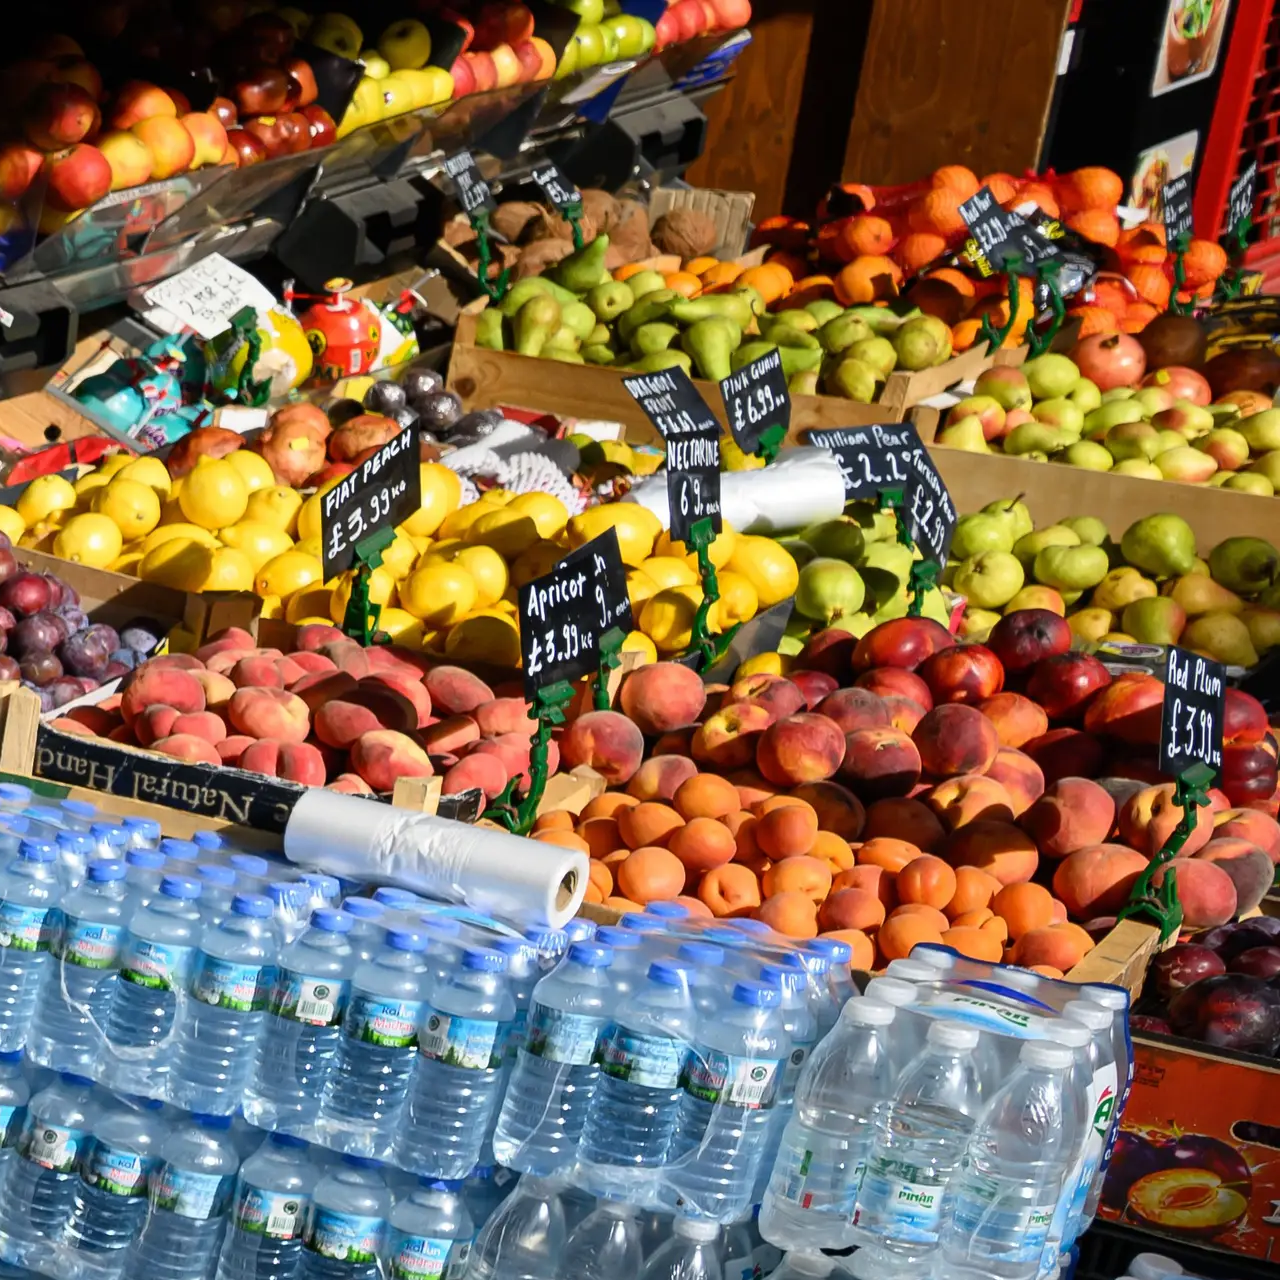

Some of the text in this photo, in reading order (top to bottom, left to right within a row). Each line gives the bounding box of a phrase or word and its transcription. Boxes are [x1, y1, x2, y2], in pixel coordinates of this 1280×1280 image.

[623, 371, 679, 401] DRAGON
[721, 351, 781, 401] PINK GUAVA
[643, 392, 678, 415] FRUIT
[732, 383, 776, 433] £6.99
[362, 428, 412, 484] PEACH
[667, 437, 720, 473] NECTARINE
[810, 423, 911, 450] William Pear
[911, 447, 942, 496] Turkish
[327, 487, 391, 560] £3.99
[527, 571, 588, 622] Apricot
[527, 623, 580, 677] £3.99
[1167, 649, 1222, 699] Red Plum
[1167, 697, 1214, 766] £3.99
[35, 747, 255, 826] Hand Natural
[898, 1190, 934, 1208] PINAR
